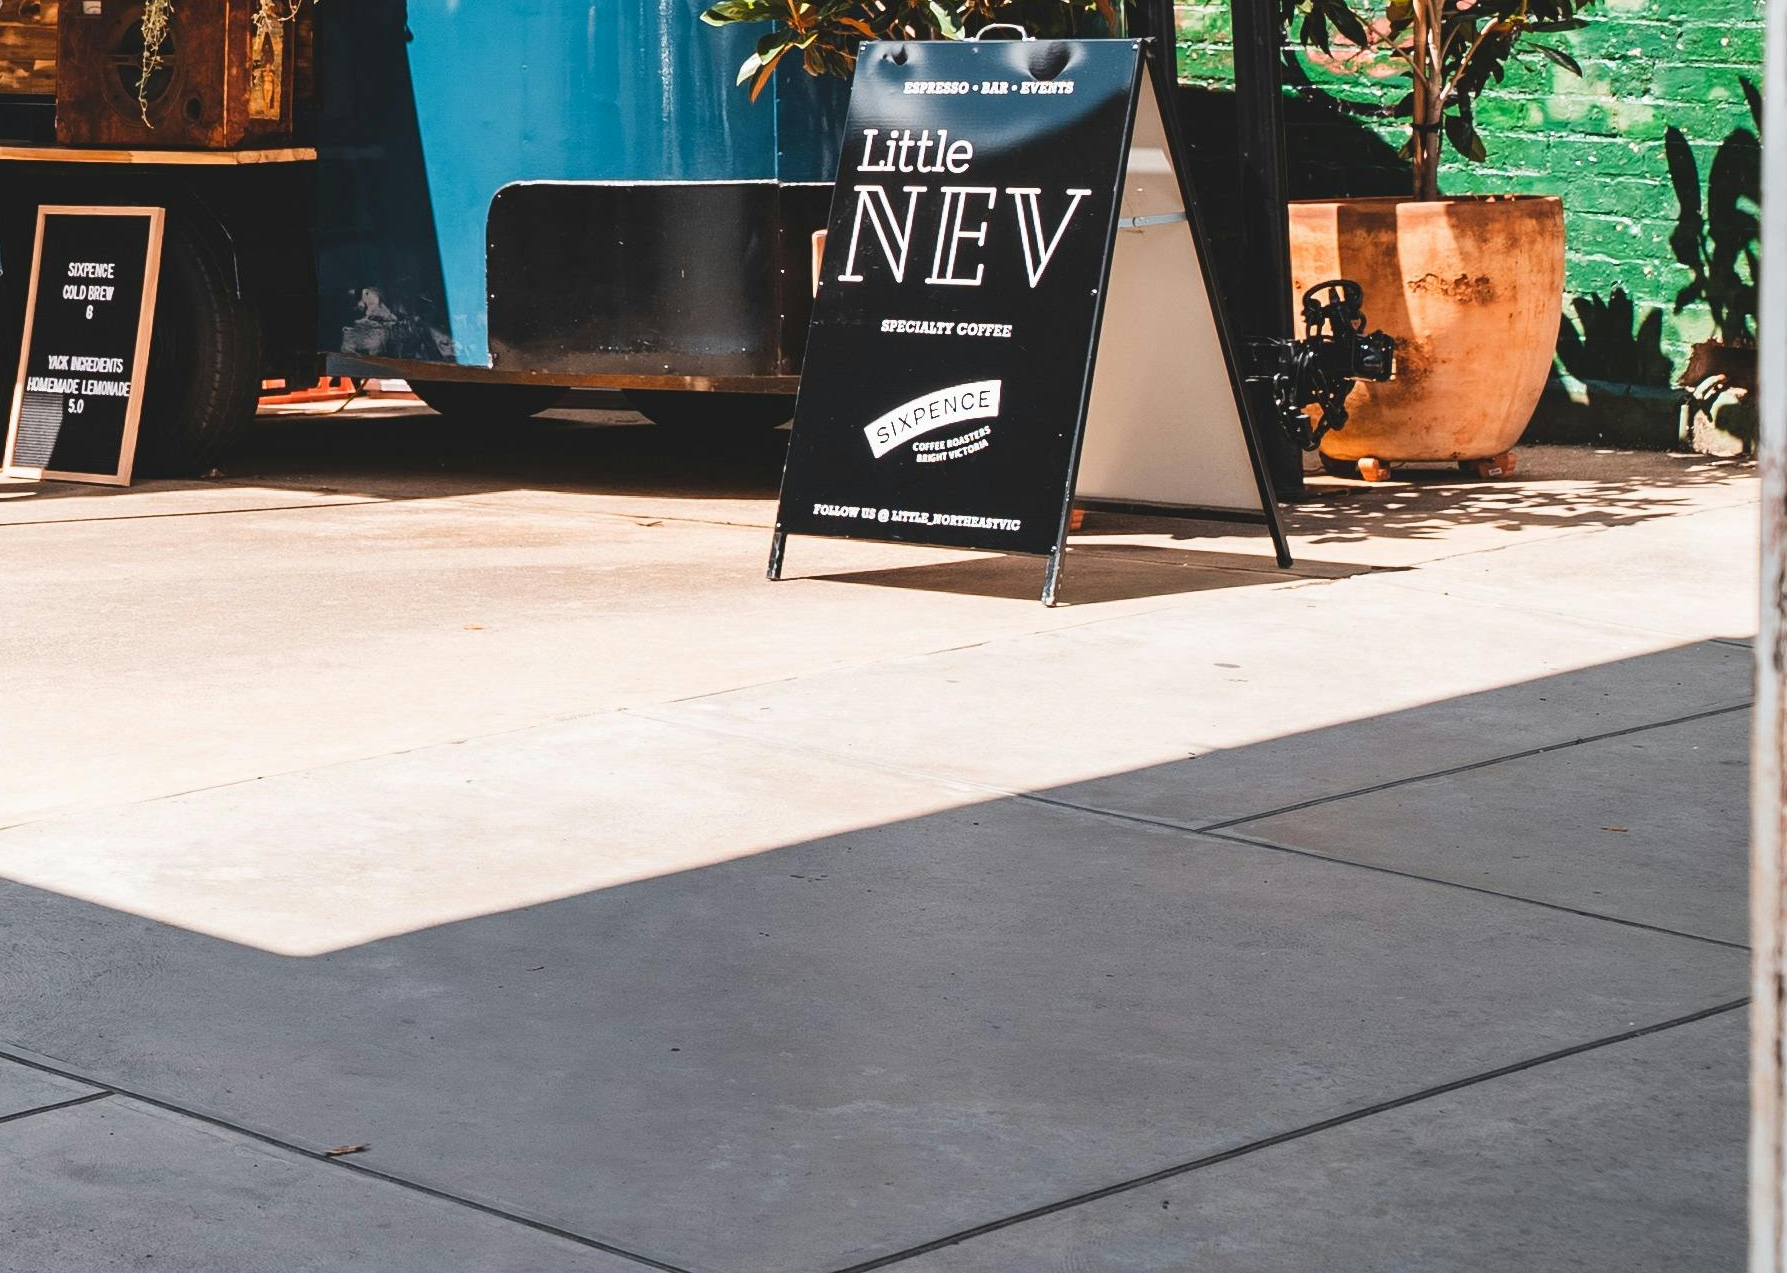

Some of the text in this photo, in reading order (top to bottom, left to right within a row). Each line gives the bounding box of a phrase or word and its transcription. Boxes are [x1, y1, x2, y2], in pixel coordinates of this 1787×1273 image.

[903, 81, 1074, 95] ESPRESSO BAR EVENTS
[857, 129, 973, 173] Little
[838, 185, 1092, 288] NEV
[67, 262, 115, 278] SIXPENCE
[63, 285, 114, 301] COLD BREW
[881, 319, 1012, 337] SPECIALTY COFFEE
[70, 356, 124, 373] INGREDIENTS
[27, 377, 131, 397] HOMEMADE LEMONADE
[67, 398, 85, 414] 5.0
[877, 390, 991, 444] SIXPENCE
[912, 425, 992, 452] COFFEE ROASTERS
[916, 439, 989, 463] BRIGHT VICTORIA
[813, 503, 1021, 531] FOLLOW US @ LITTLE_NORTHEASTVIC
